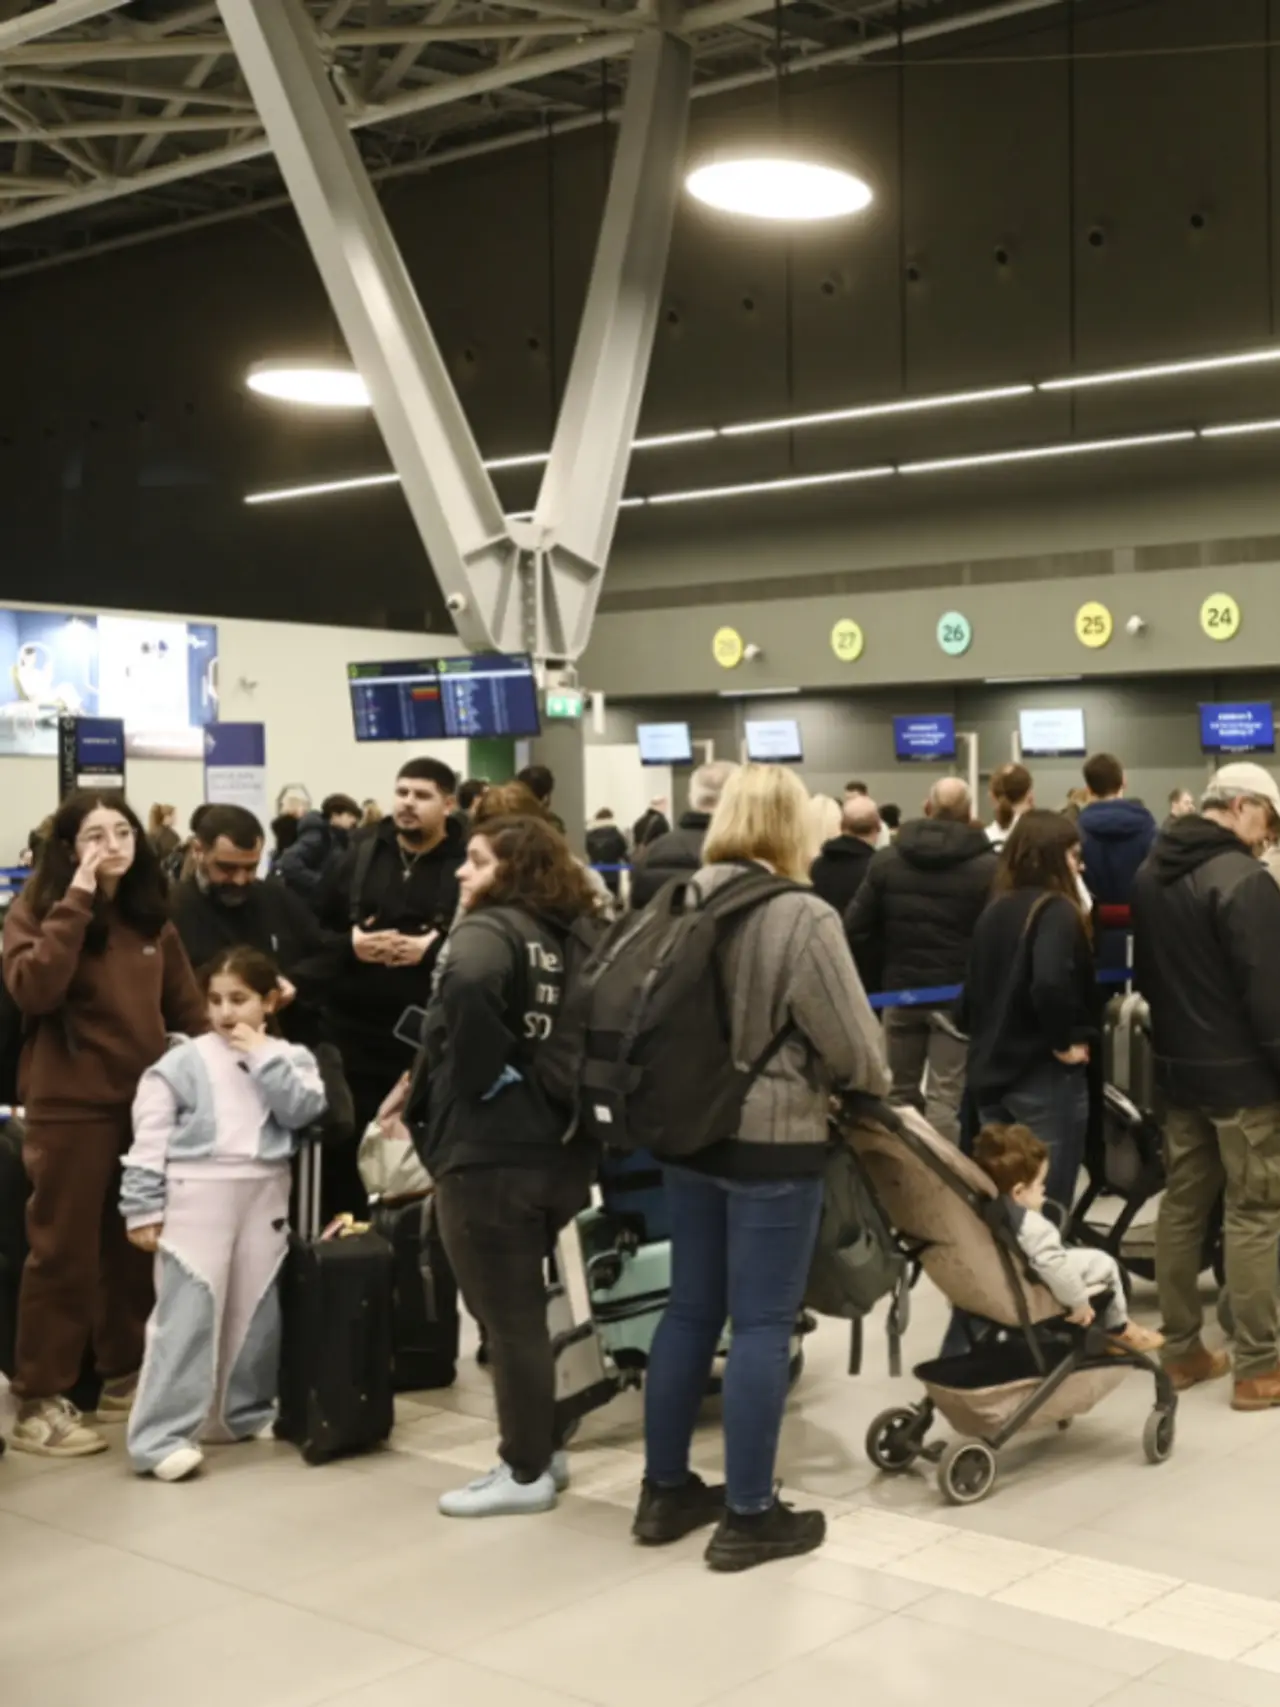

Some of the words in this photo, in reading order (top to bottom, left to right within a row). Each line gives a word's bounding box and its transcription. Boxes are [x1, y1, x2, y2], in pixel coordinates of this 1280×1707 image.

[1083, 616, 1106, 635] 25
[1208, 607, 1233, 628] 24
[837, 631, 857, 650] 27
[943, 625, 965, 644] 26
